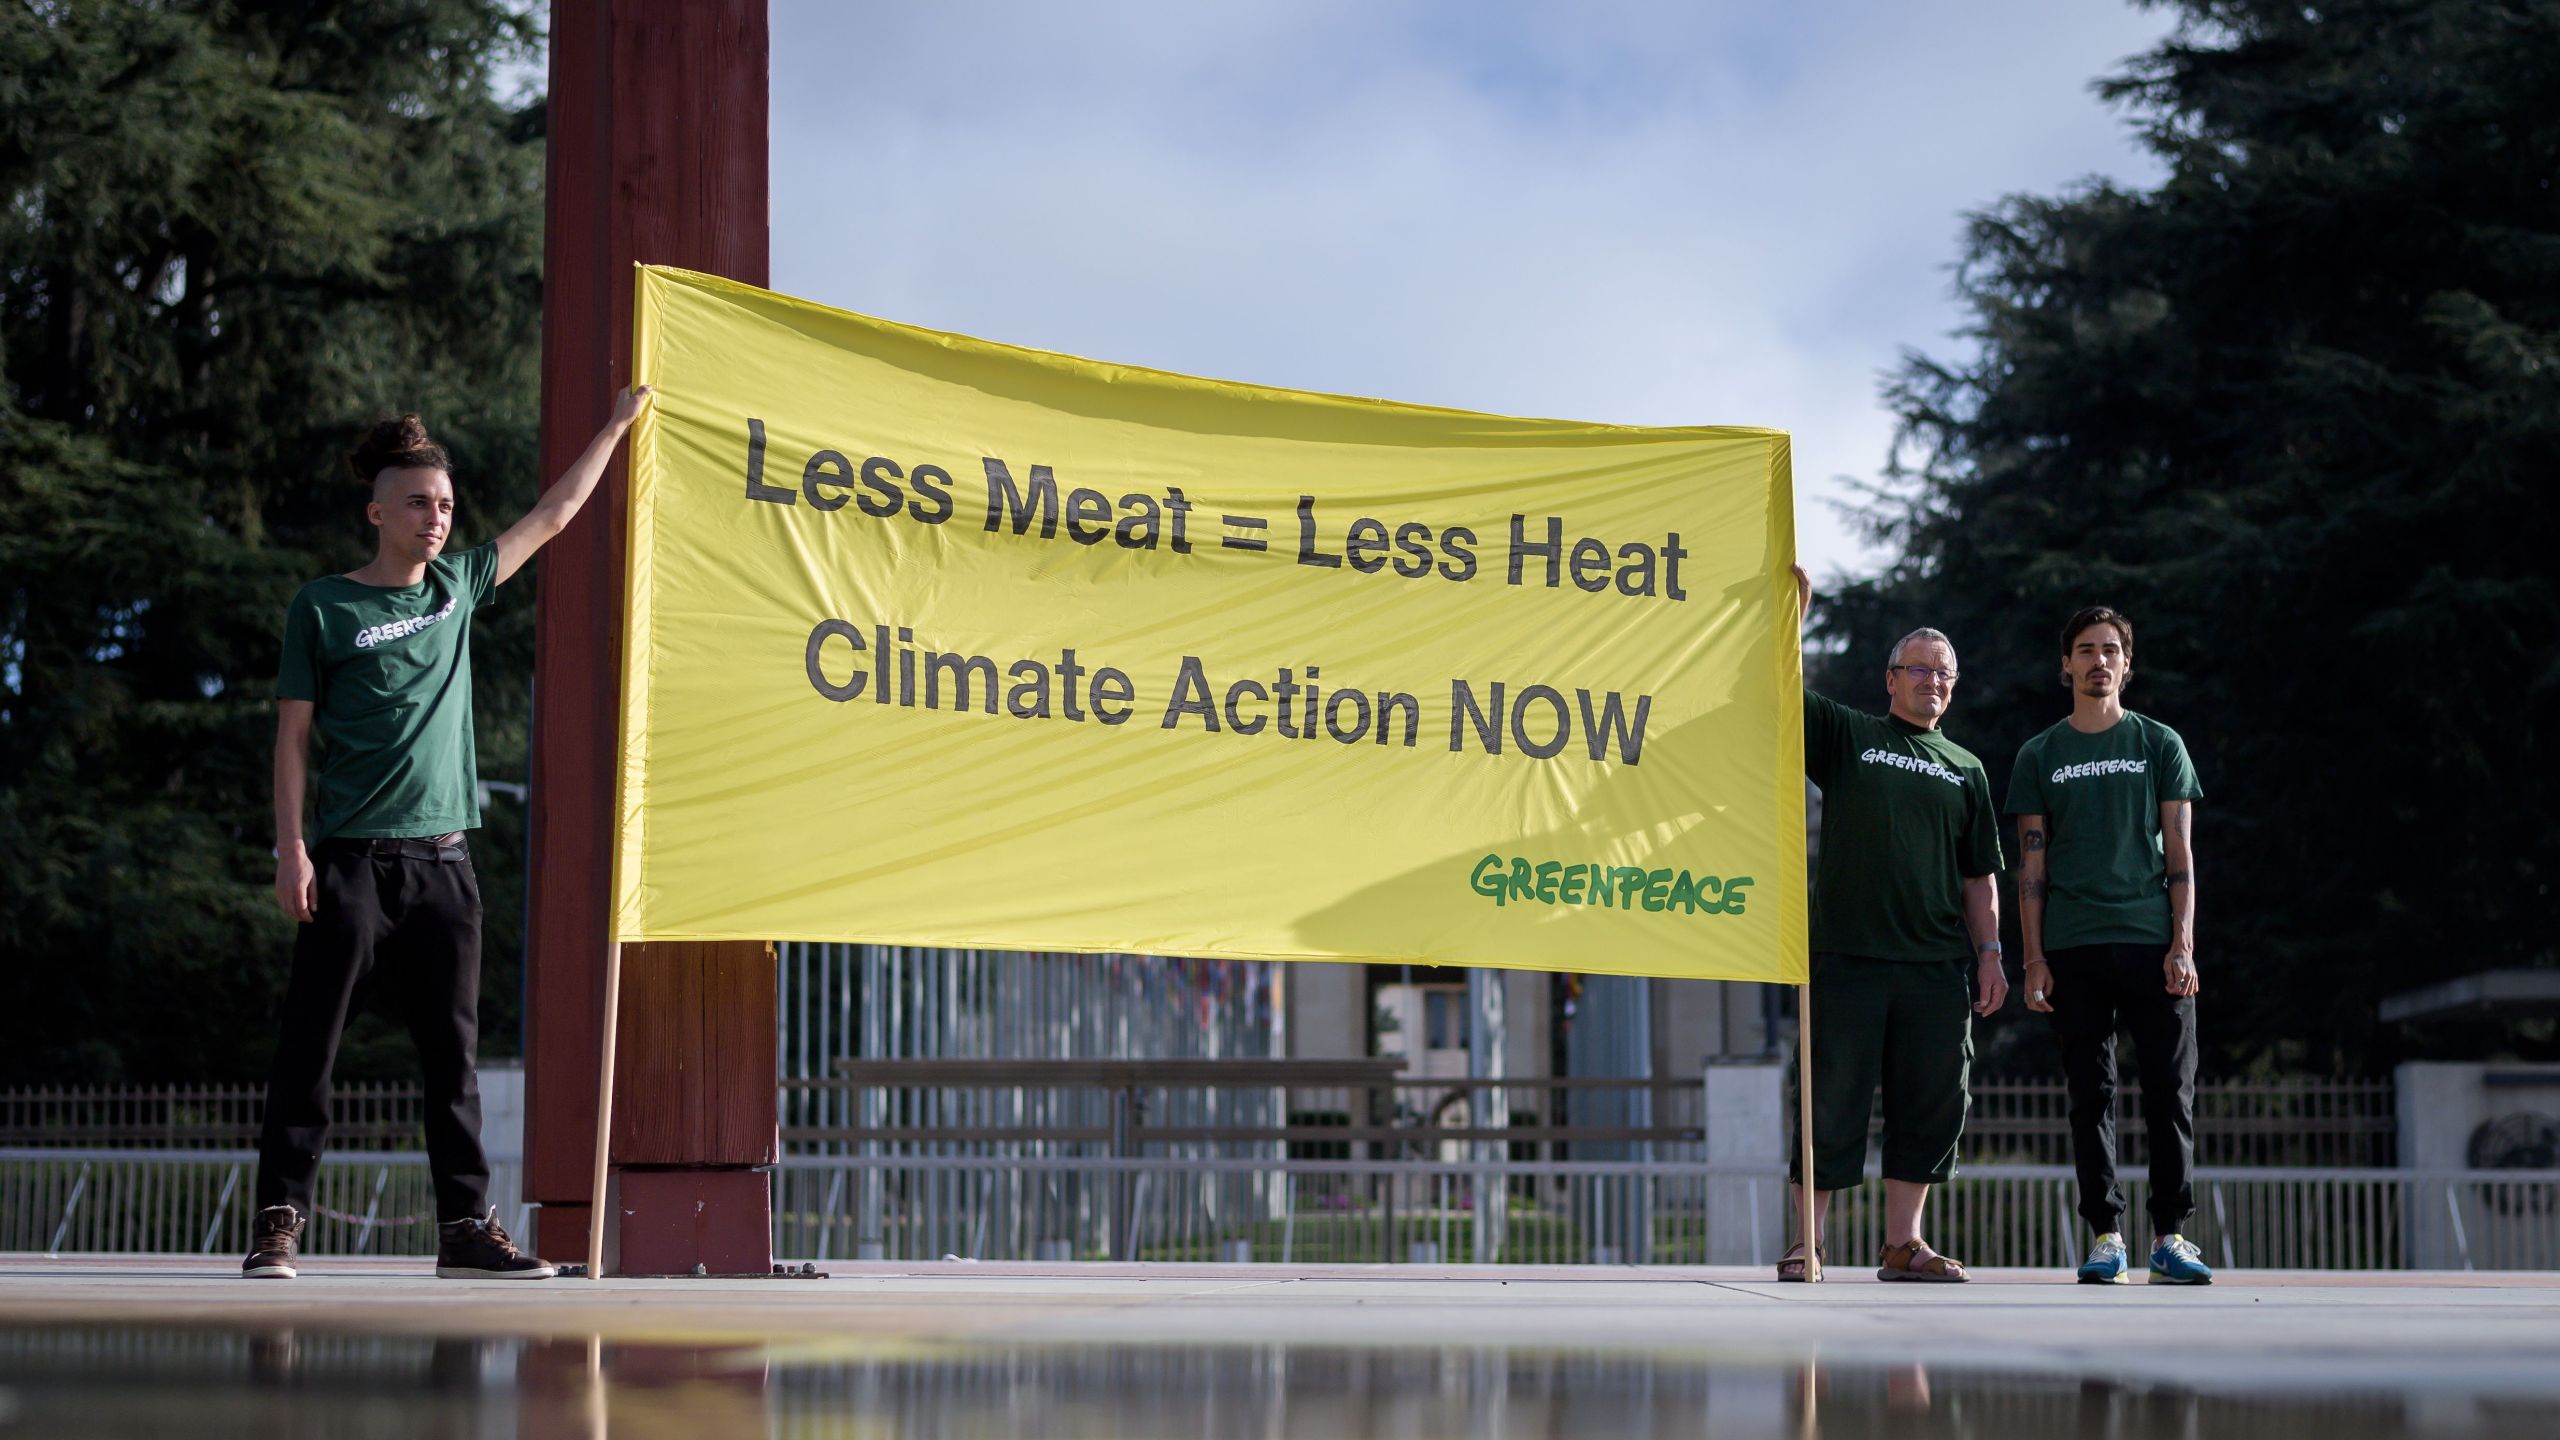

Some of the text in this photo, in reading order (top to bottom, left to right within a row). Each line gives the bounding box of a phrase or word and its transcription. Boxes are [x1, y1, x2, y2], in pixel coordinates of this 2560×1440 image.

[746, 418, 1688, 602] Less Meat = Less Heat
[806, 619, 1652, 767] Climate Action NOW
[1861, 747, 1965, 786] GREENPEACE
[2051, 759, 2147, 784] GREENPEACE
[1471, 854, 1755, 916] GREENPEACE
